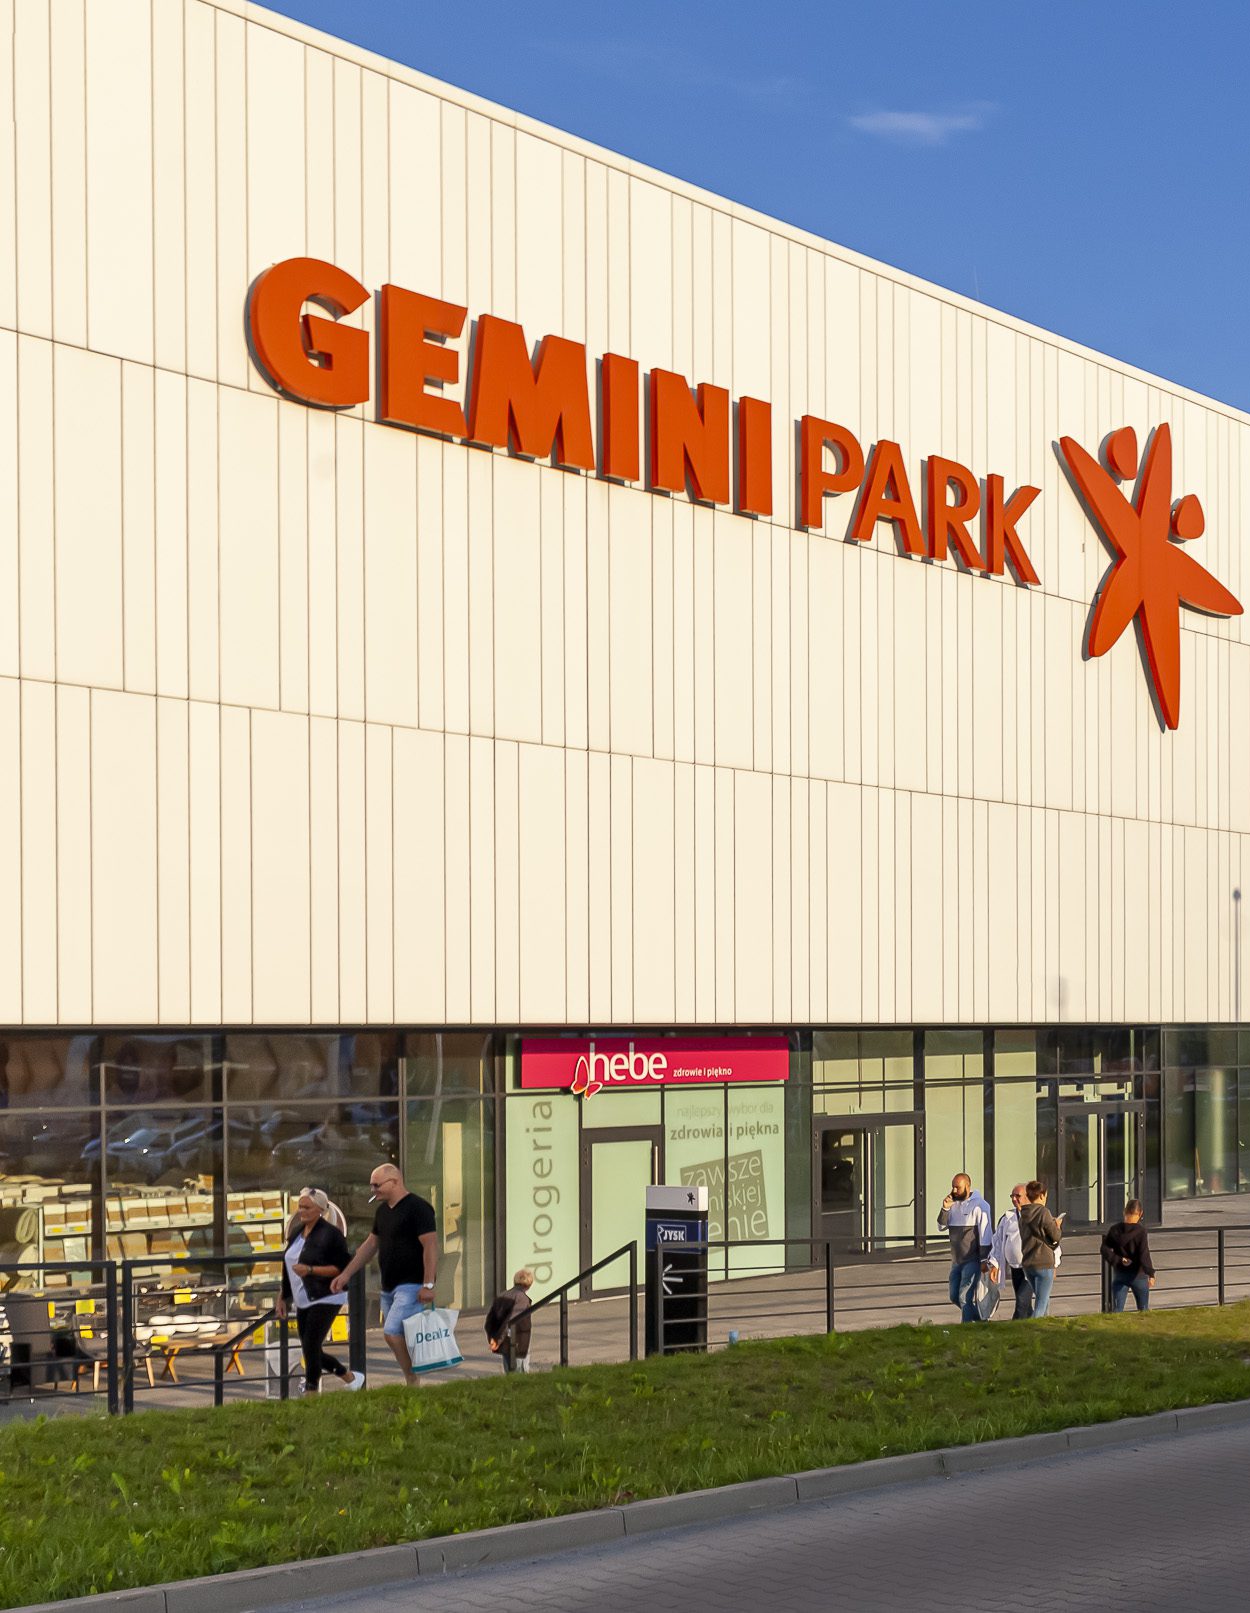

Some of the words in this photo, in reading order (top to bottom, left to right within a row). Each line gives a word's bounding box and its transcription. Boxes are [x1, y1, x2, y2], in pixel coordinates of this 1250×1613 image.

[246, 257, 773, 517] GEMINI
[800, 414, 1042, 586] PARK
[589, 1042, 668, 1081] hebe
[673, 1067, 702, 1077] zdrowie
[707, 1067, 732, 1078] piękno
[671, 1124, 723, 1140] zdrowia
[729, 1123, 733, 1136] i
[737, 1121, 779, 1140] piękna
[525, 1100, 560, 1285] drogeria
[663, 1230, 685, 1241] JYSK
[708, 1206, 767, 1240] enie
[416, 1327, 450, 1344] Dealz
